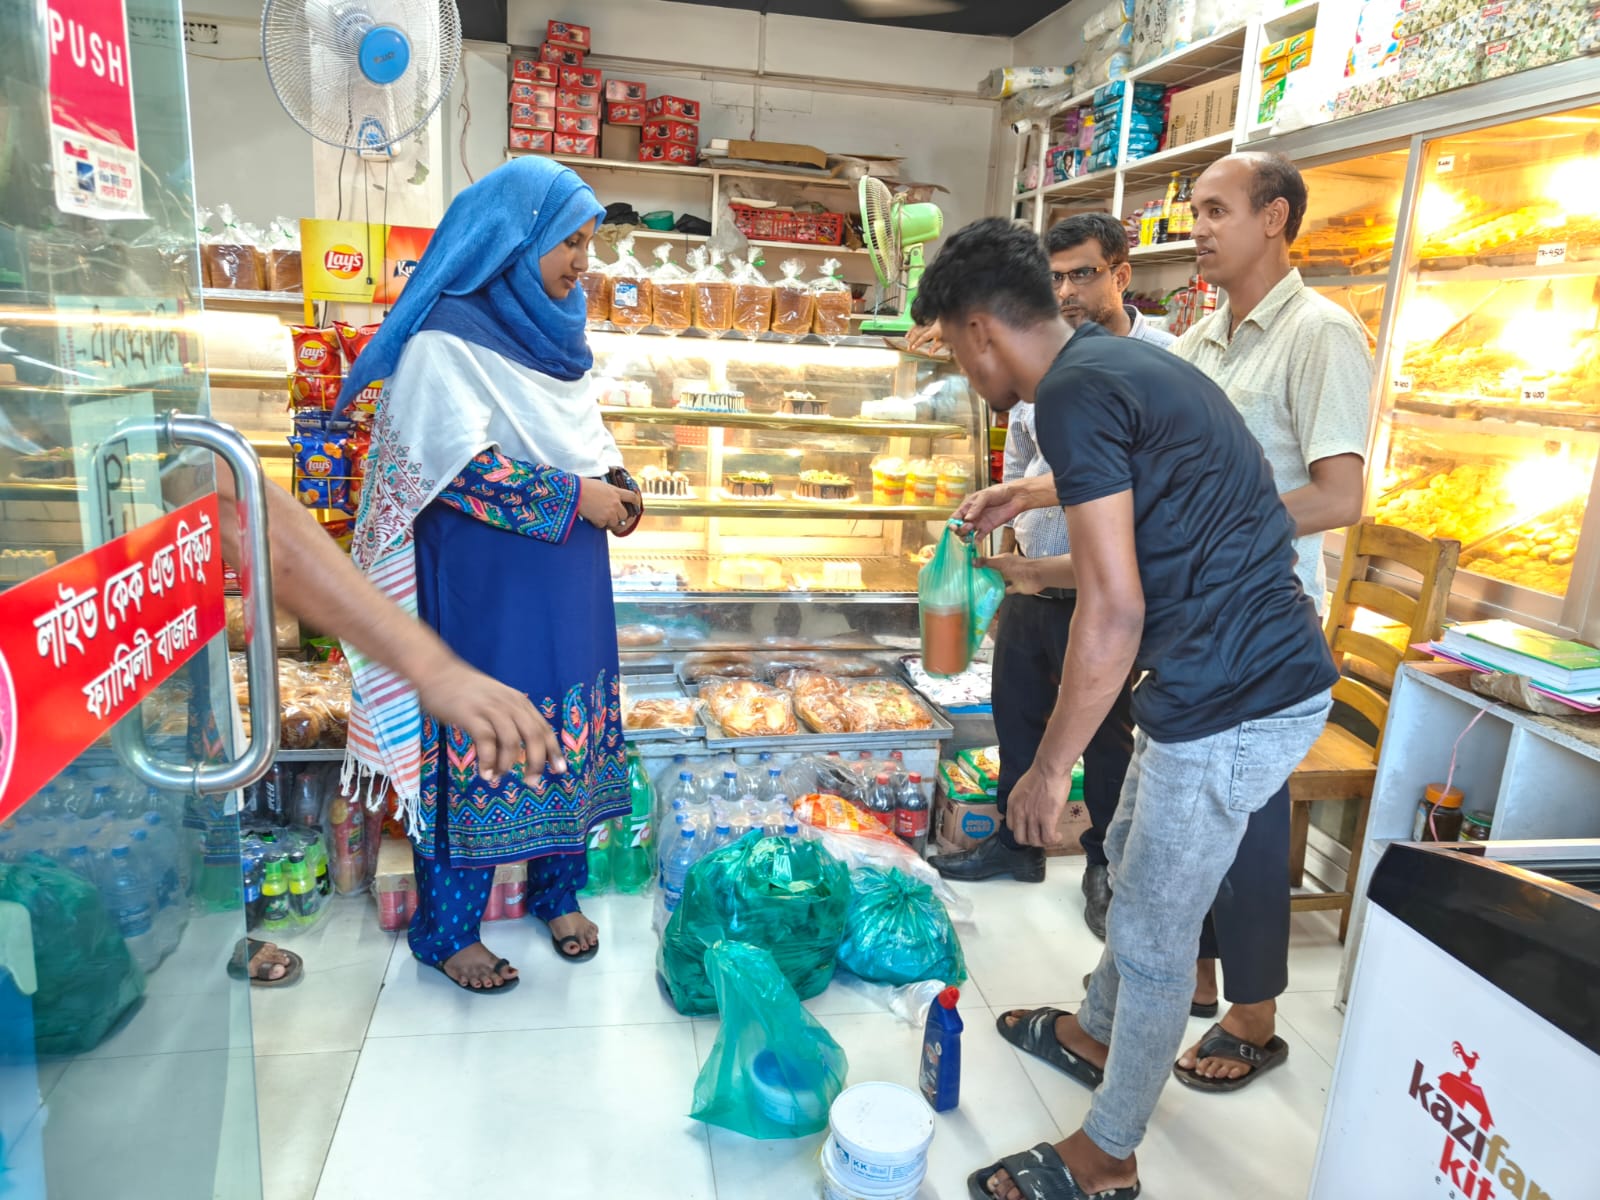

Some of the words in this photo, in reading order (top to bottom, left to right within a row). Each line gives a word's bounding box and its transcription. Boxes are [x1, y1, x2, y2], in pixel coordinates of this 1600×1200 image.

[48, 7, 125, 88] PUSH
[326, 250, 362, 273] Lay's
[299, 345, 326, 361] Lay's
[308, 460, 331, 473] Lay's
[33, 582, 99, 669] লাইভ
[103, 560, 145, 632] কেক
[154, 604, 198, 665] বাজার
